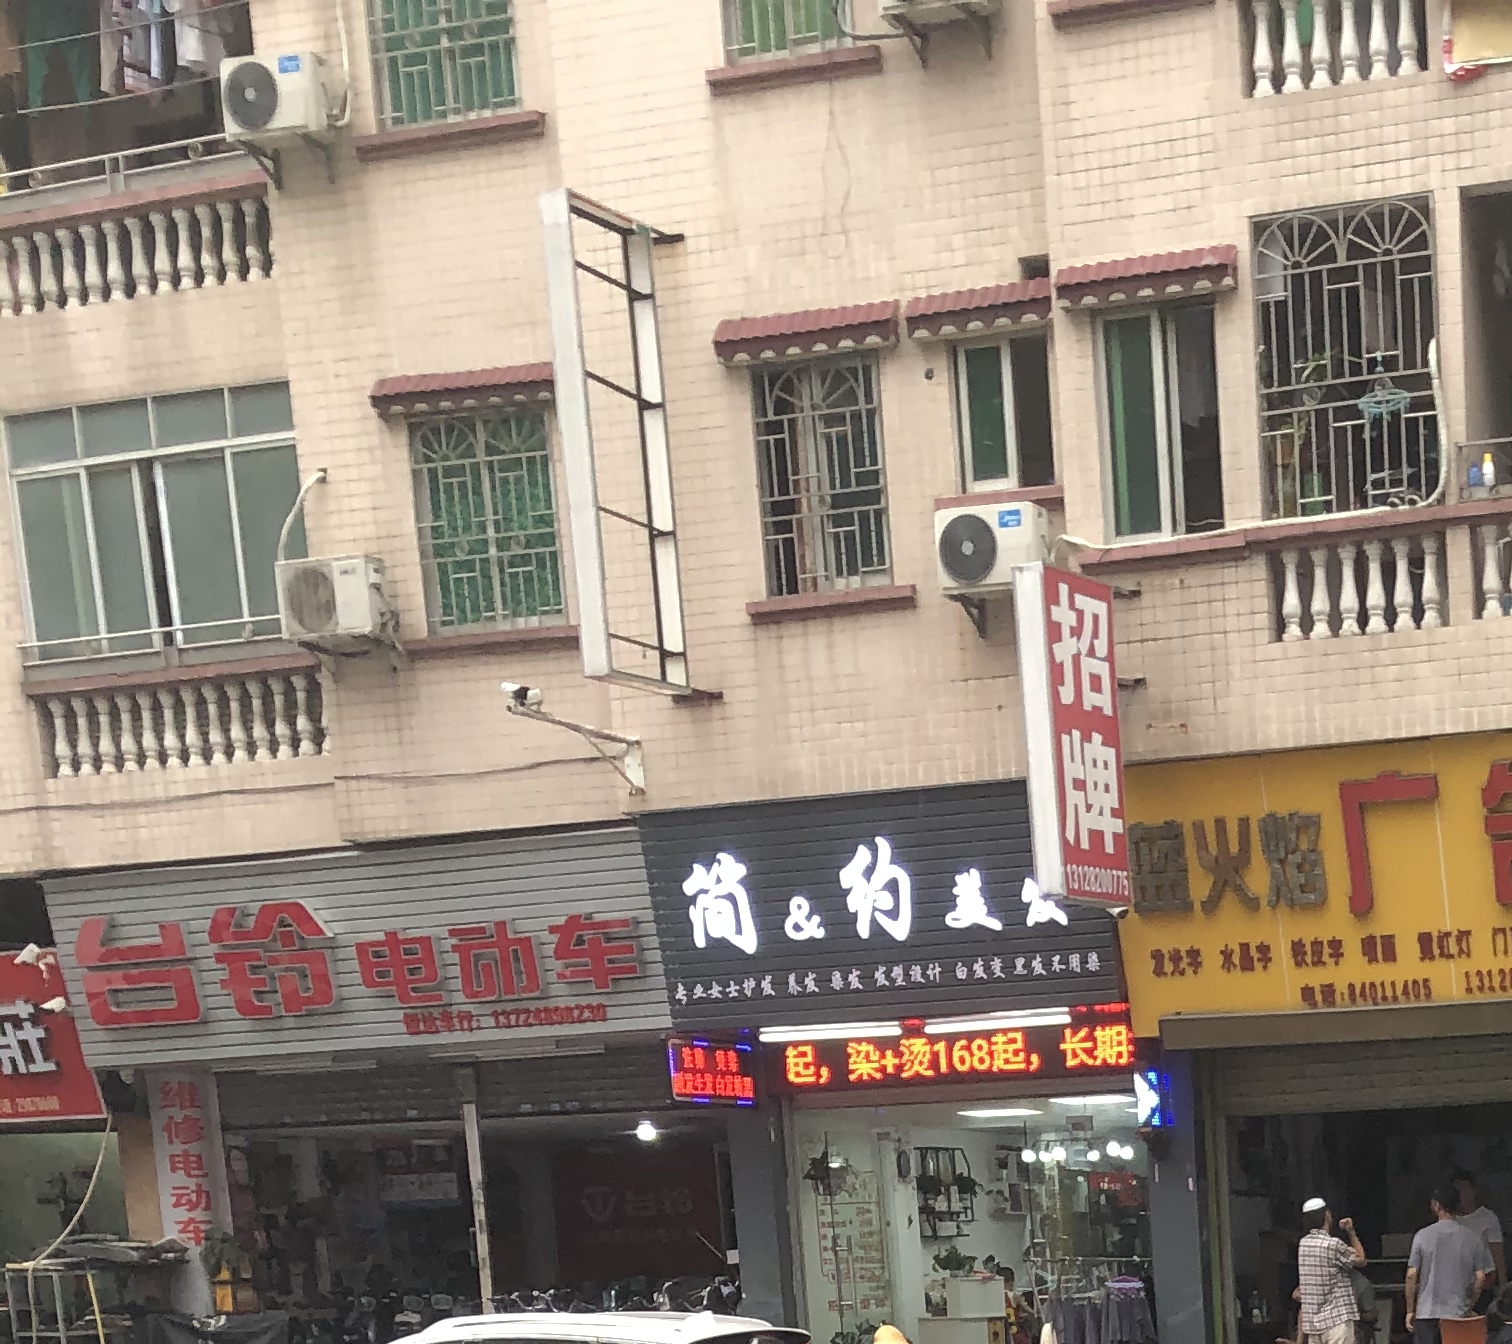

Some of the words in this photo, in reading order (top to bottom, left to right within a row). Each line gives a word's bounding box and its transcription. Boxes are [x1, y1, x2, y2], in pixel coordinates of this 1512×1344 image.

[158, 1079, 214, 1247] 维修电动车
